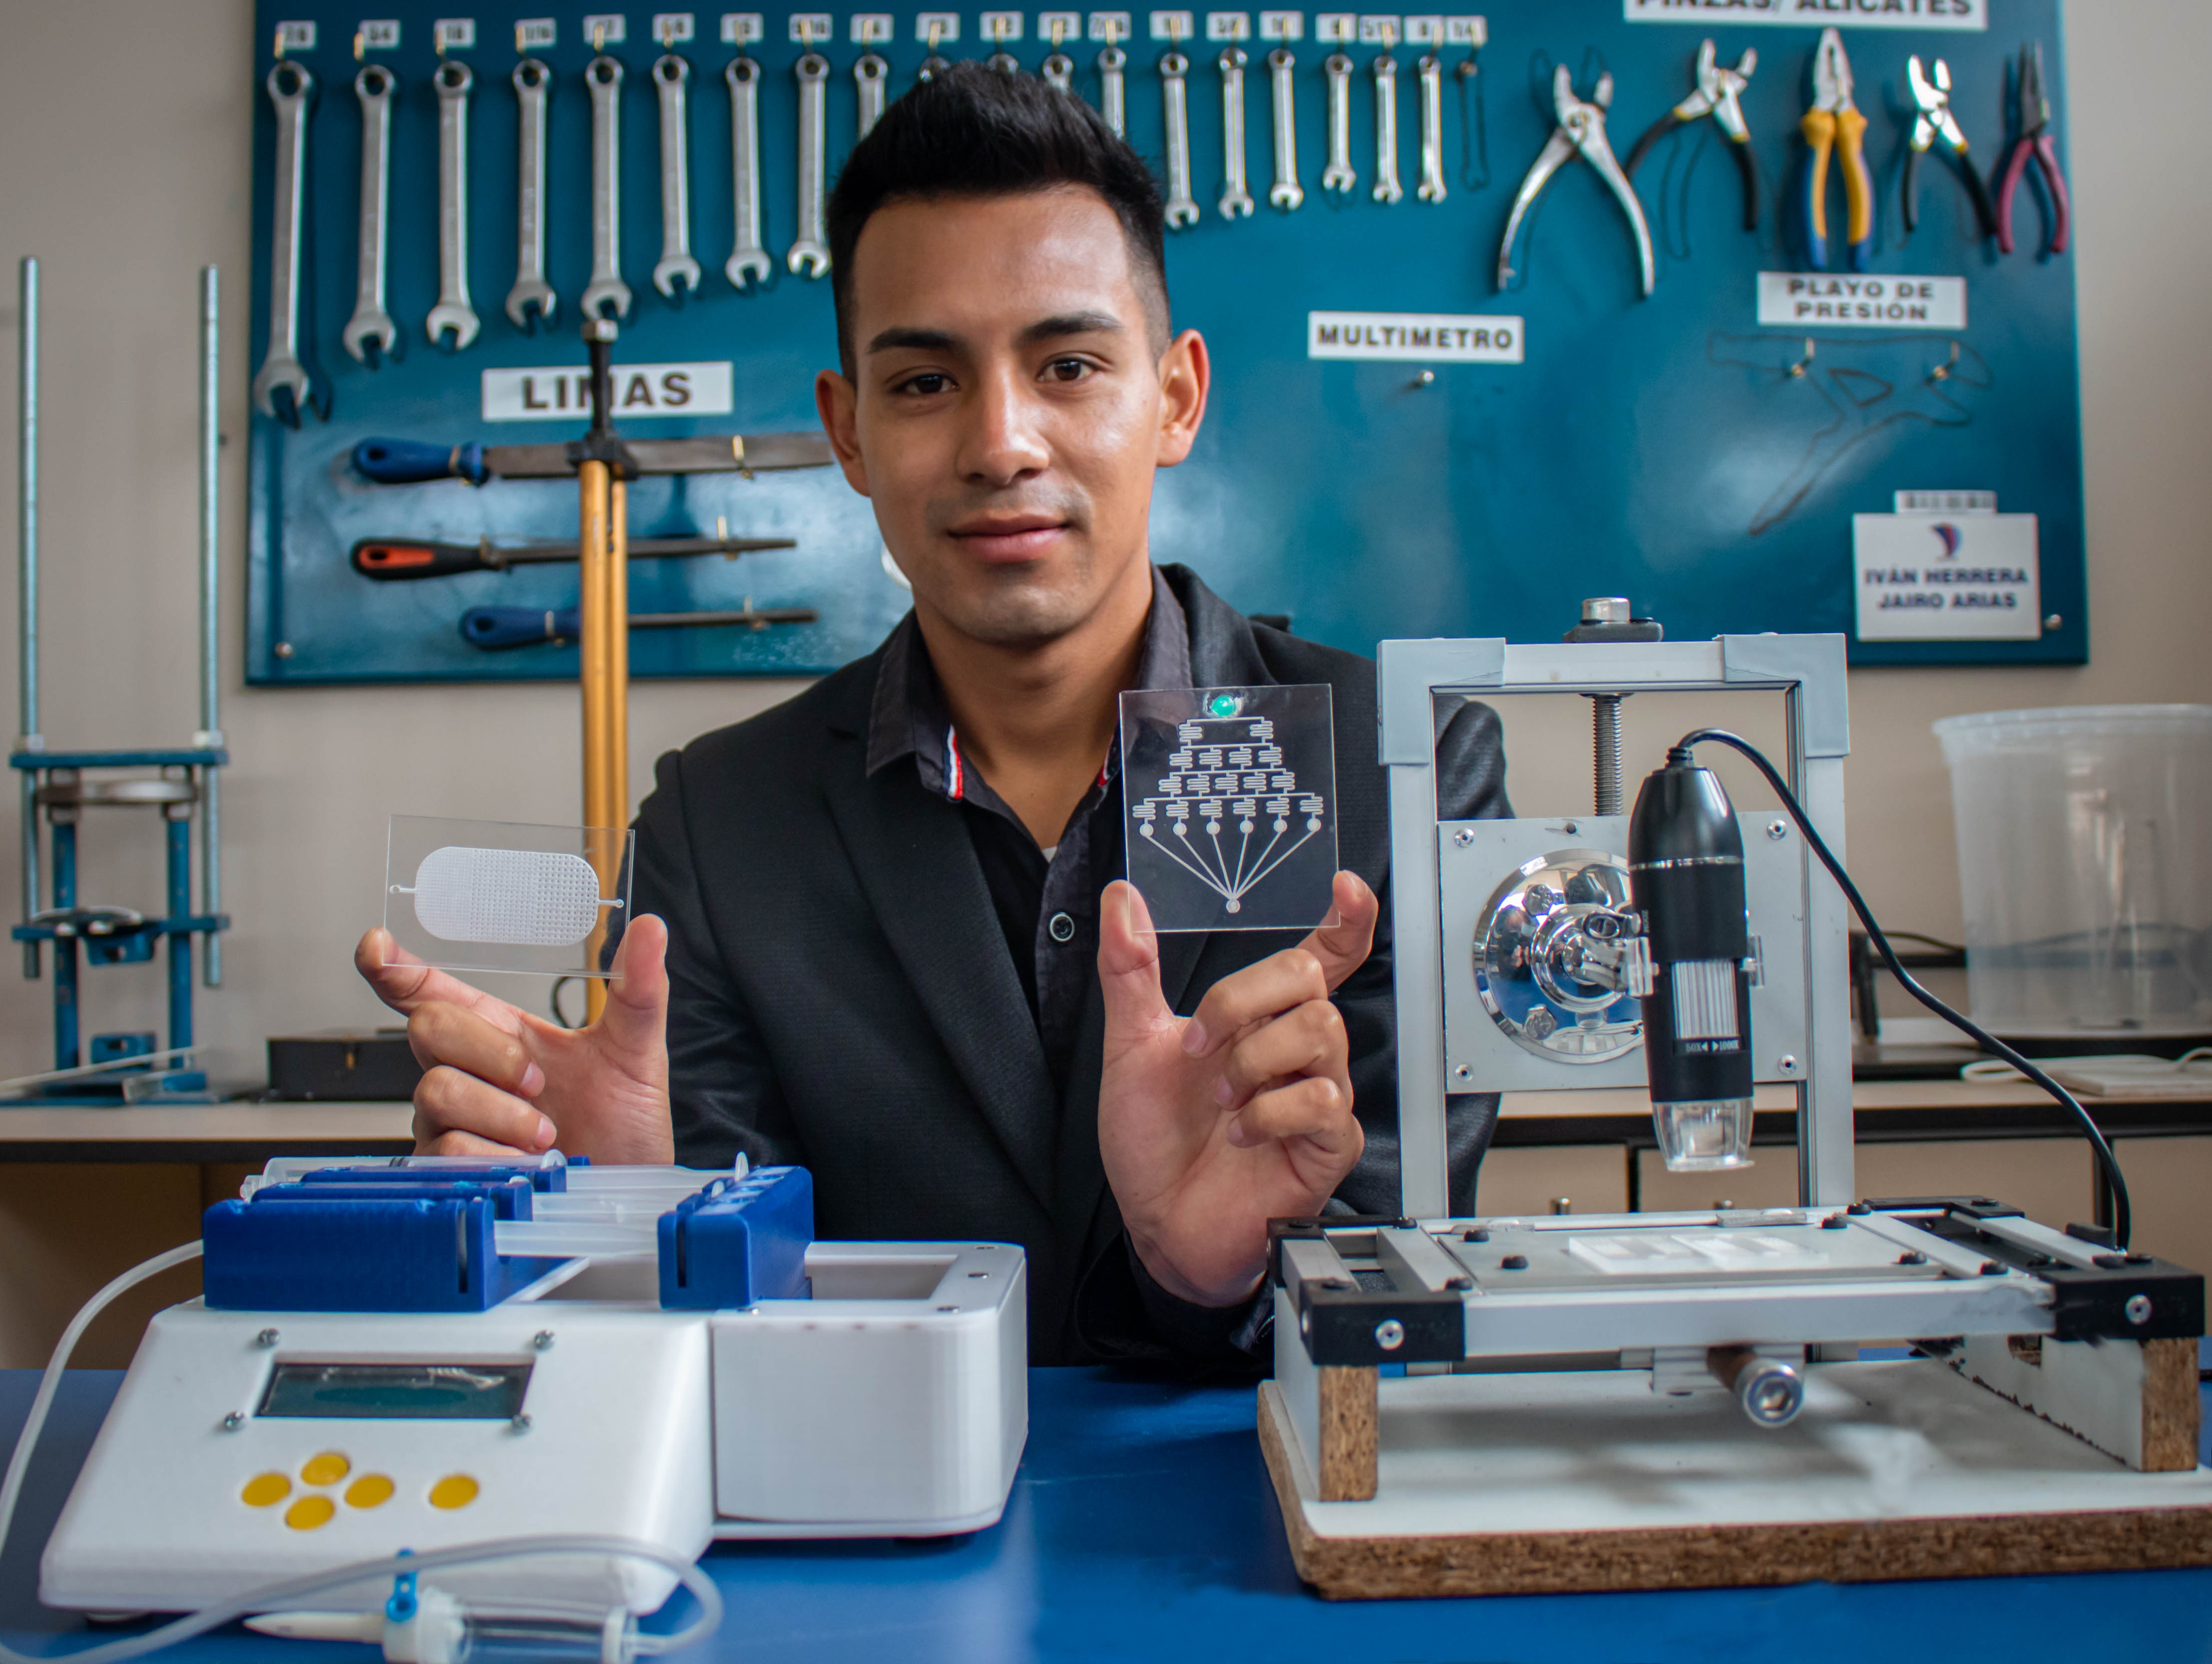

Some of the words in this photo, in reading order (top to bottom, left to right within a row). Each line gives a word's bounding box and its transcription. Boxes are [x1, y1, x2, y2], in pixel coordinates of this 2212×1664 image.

[1787, 279, 1884, 297] PLAYO
[1897, 282, 1933, 298] DE
[1318, 325, 1512, 349] MULTIMETRO
[1925, 568, 2028, 583] HERRERA
[1879, 593, 1943, 609] JAIRO
[1952, 592, 2016, 608] ARIAS
